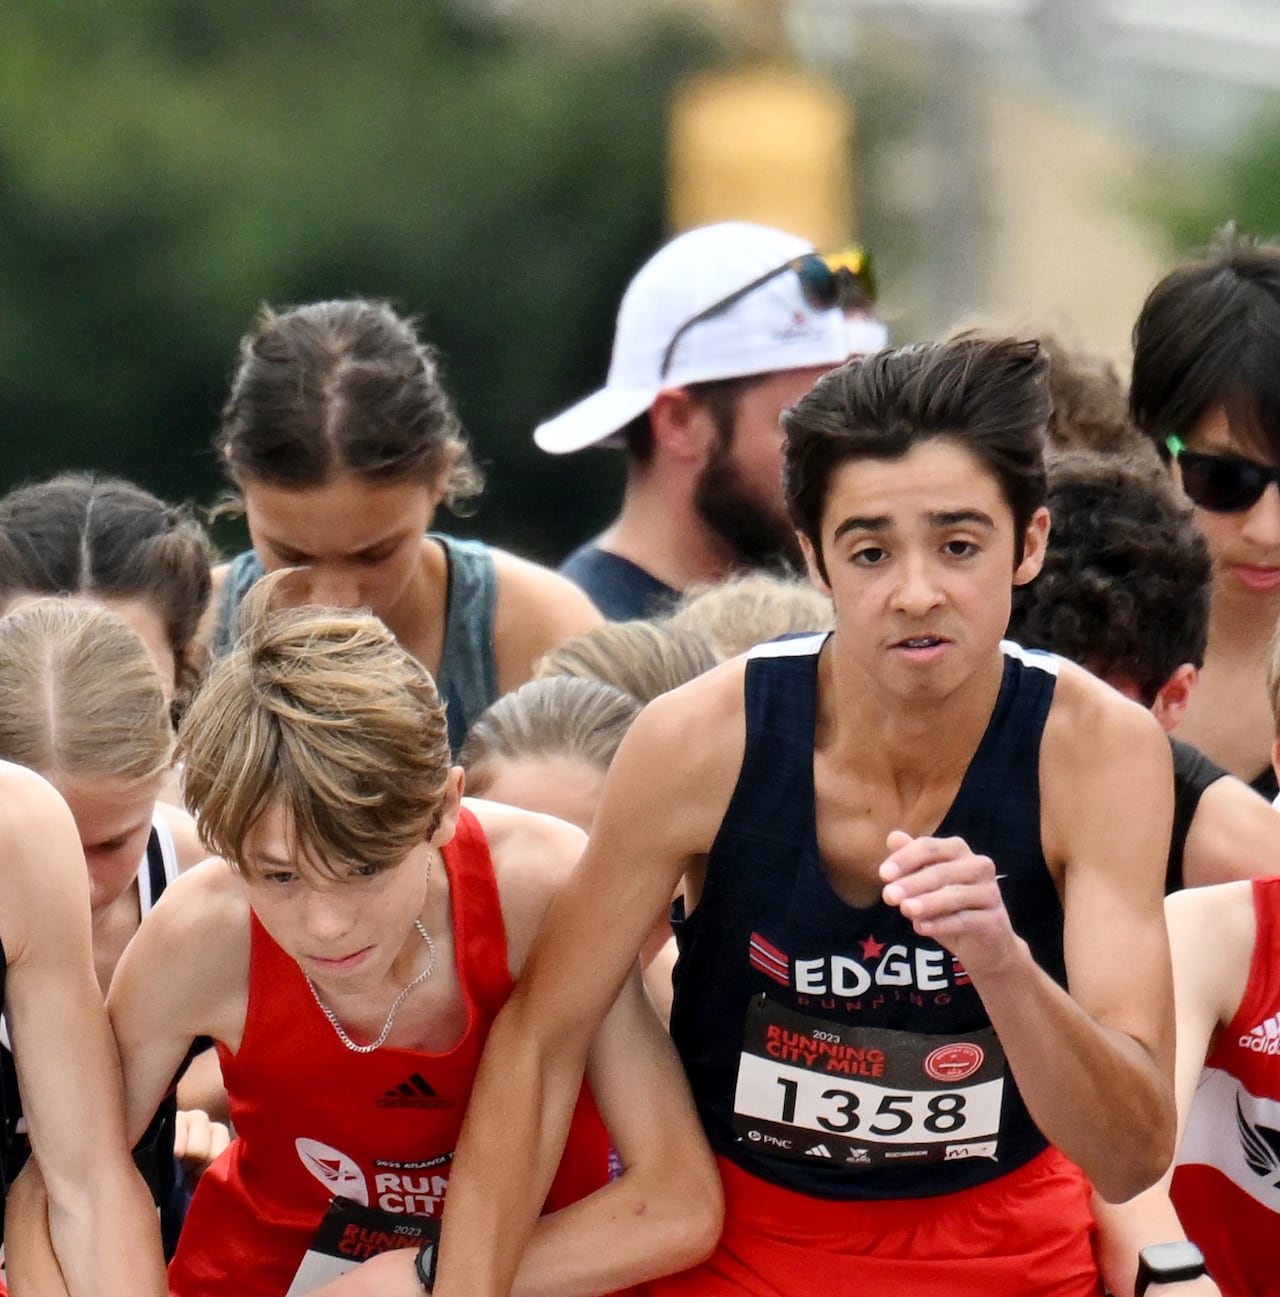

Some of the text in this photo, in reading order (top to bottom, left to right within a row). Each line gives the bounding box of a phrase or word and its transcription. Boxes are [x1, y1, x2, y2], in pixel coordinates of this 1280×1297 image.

[794, 944, 949, 998] EDGE
[766, 1024, 885, 1063] RUNNING
[812, 1028, 841, 1044] 2023
[1238, 1034, 1280, 1056] adid
[765, 1040, 885, 1078] CITY MILE
[776, 1077, 967, 1137] 1358
[762, 1134, 793, 1150] PNC
[378, 1193, 445, 1214] CIT
[393, 1225, 422, 1237] 2023
